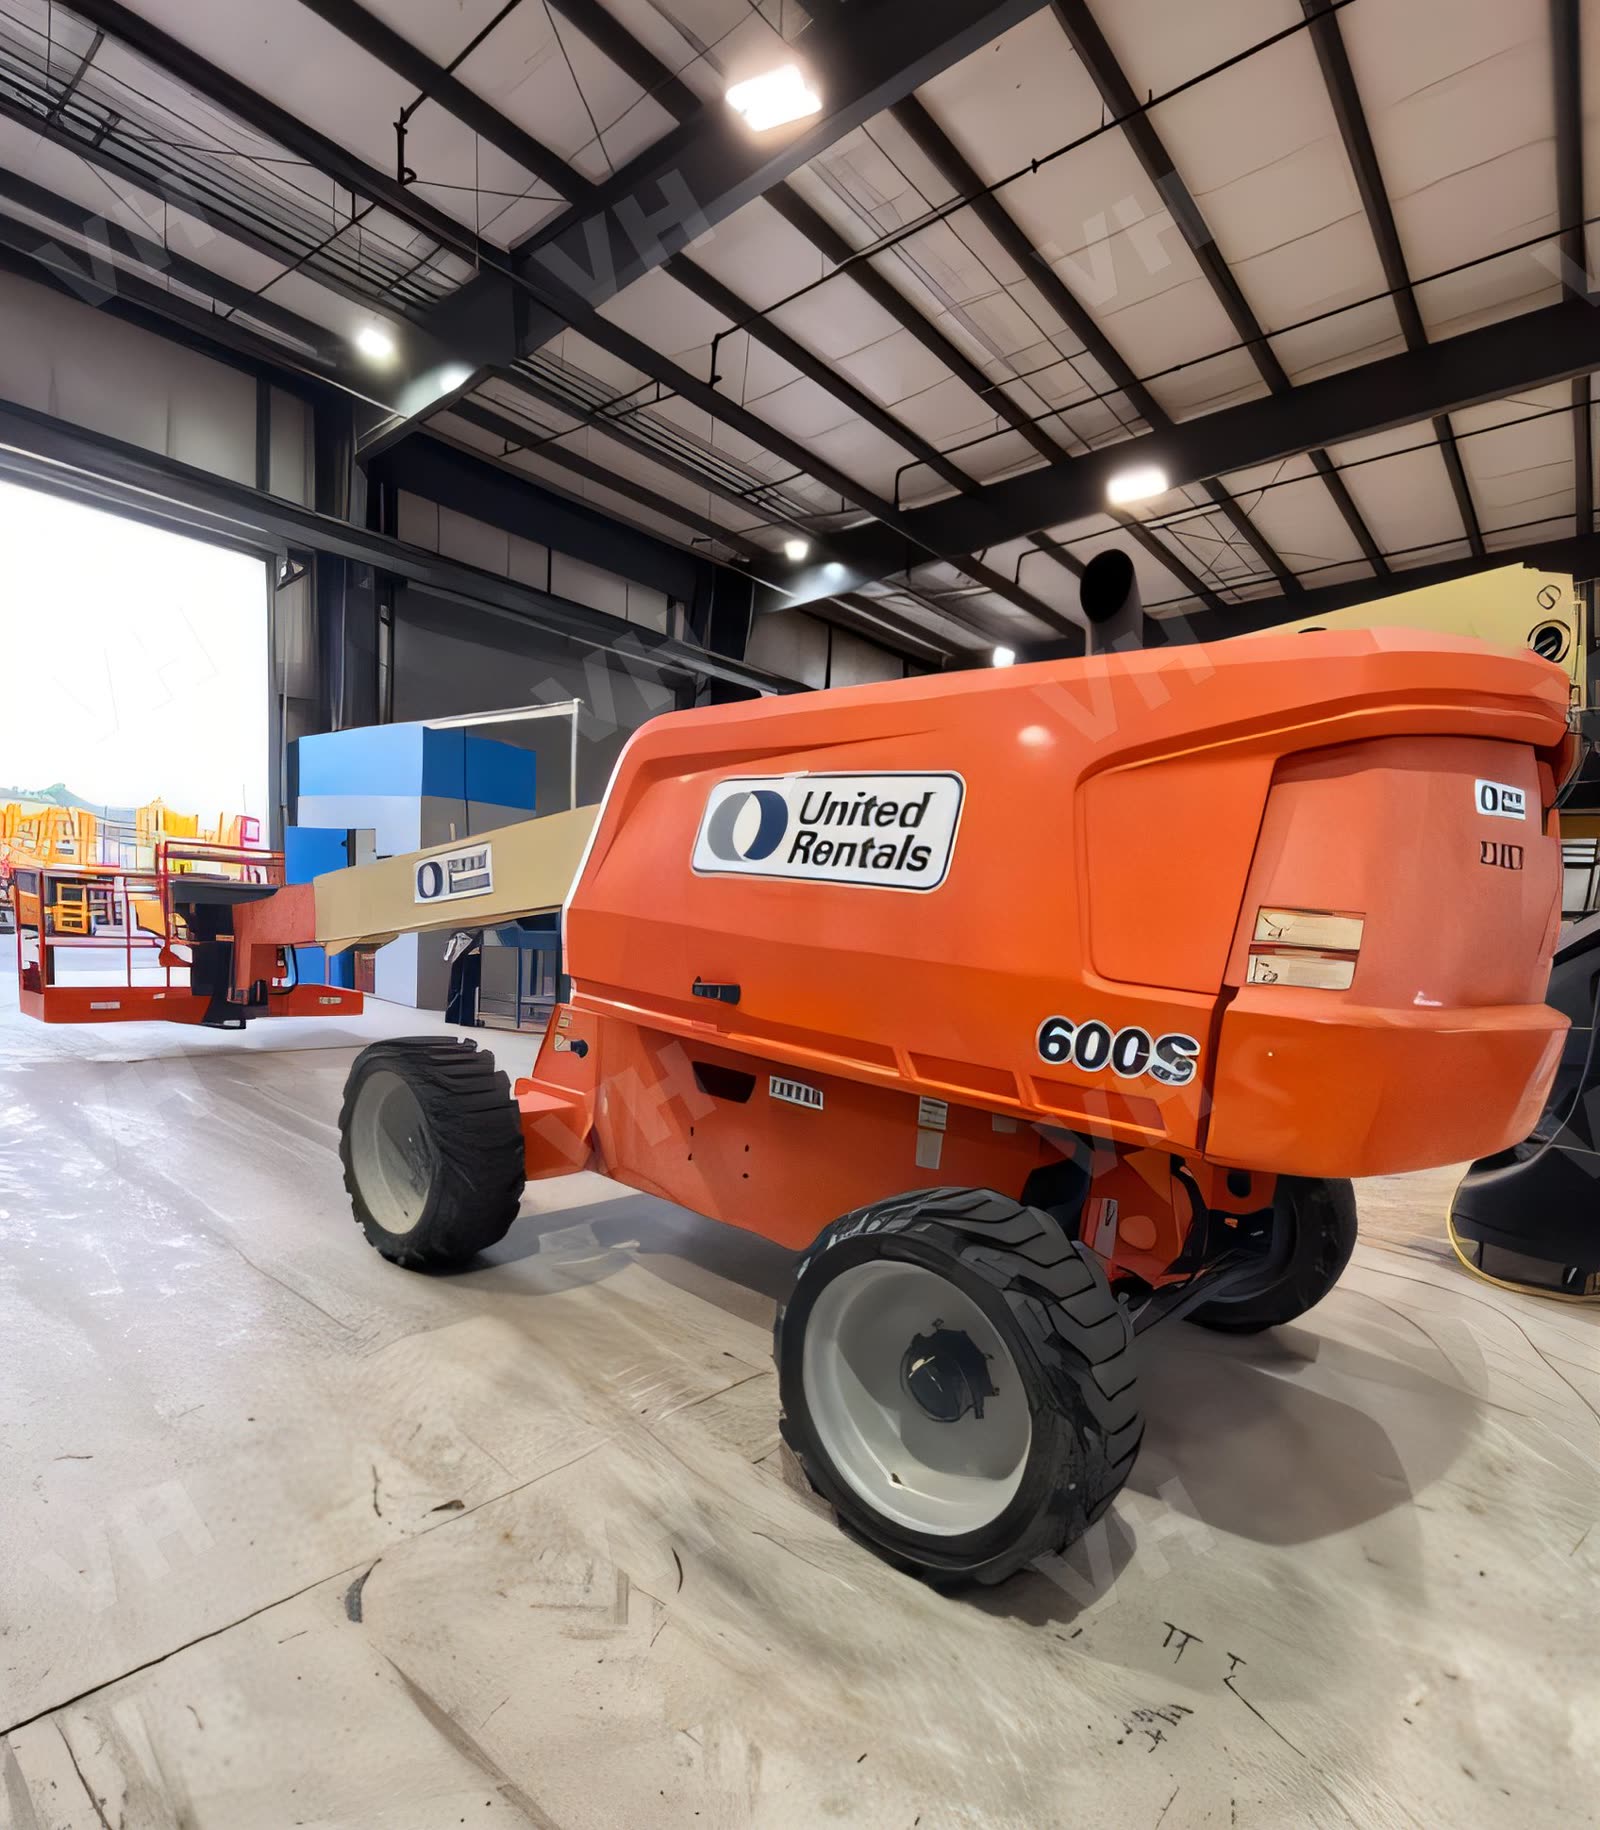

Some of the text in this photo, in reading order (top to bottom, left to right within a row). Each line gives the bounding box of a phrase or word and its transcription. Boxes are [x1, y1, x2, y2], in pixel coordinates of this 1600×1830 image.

[799, 791, 936, 828] United
[787, 830, 932, 872] Rentals
[1036, 1015, 1200, 1086] 600S
